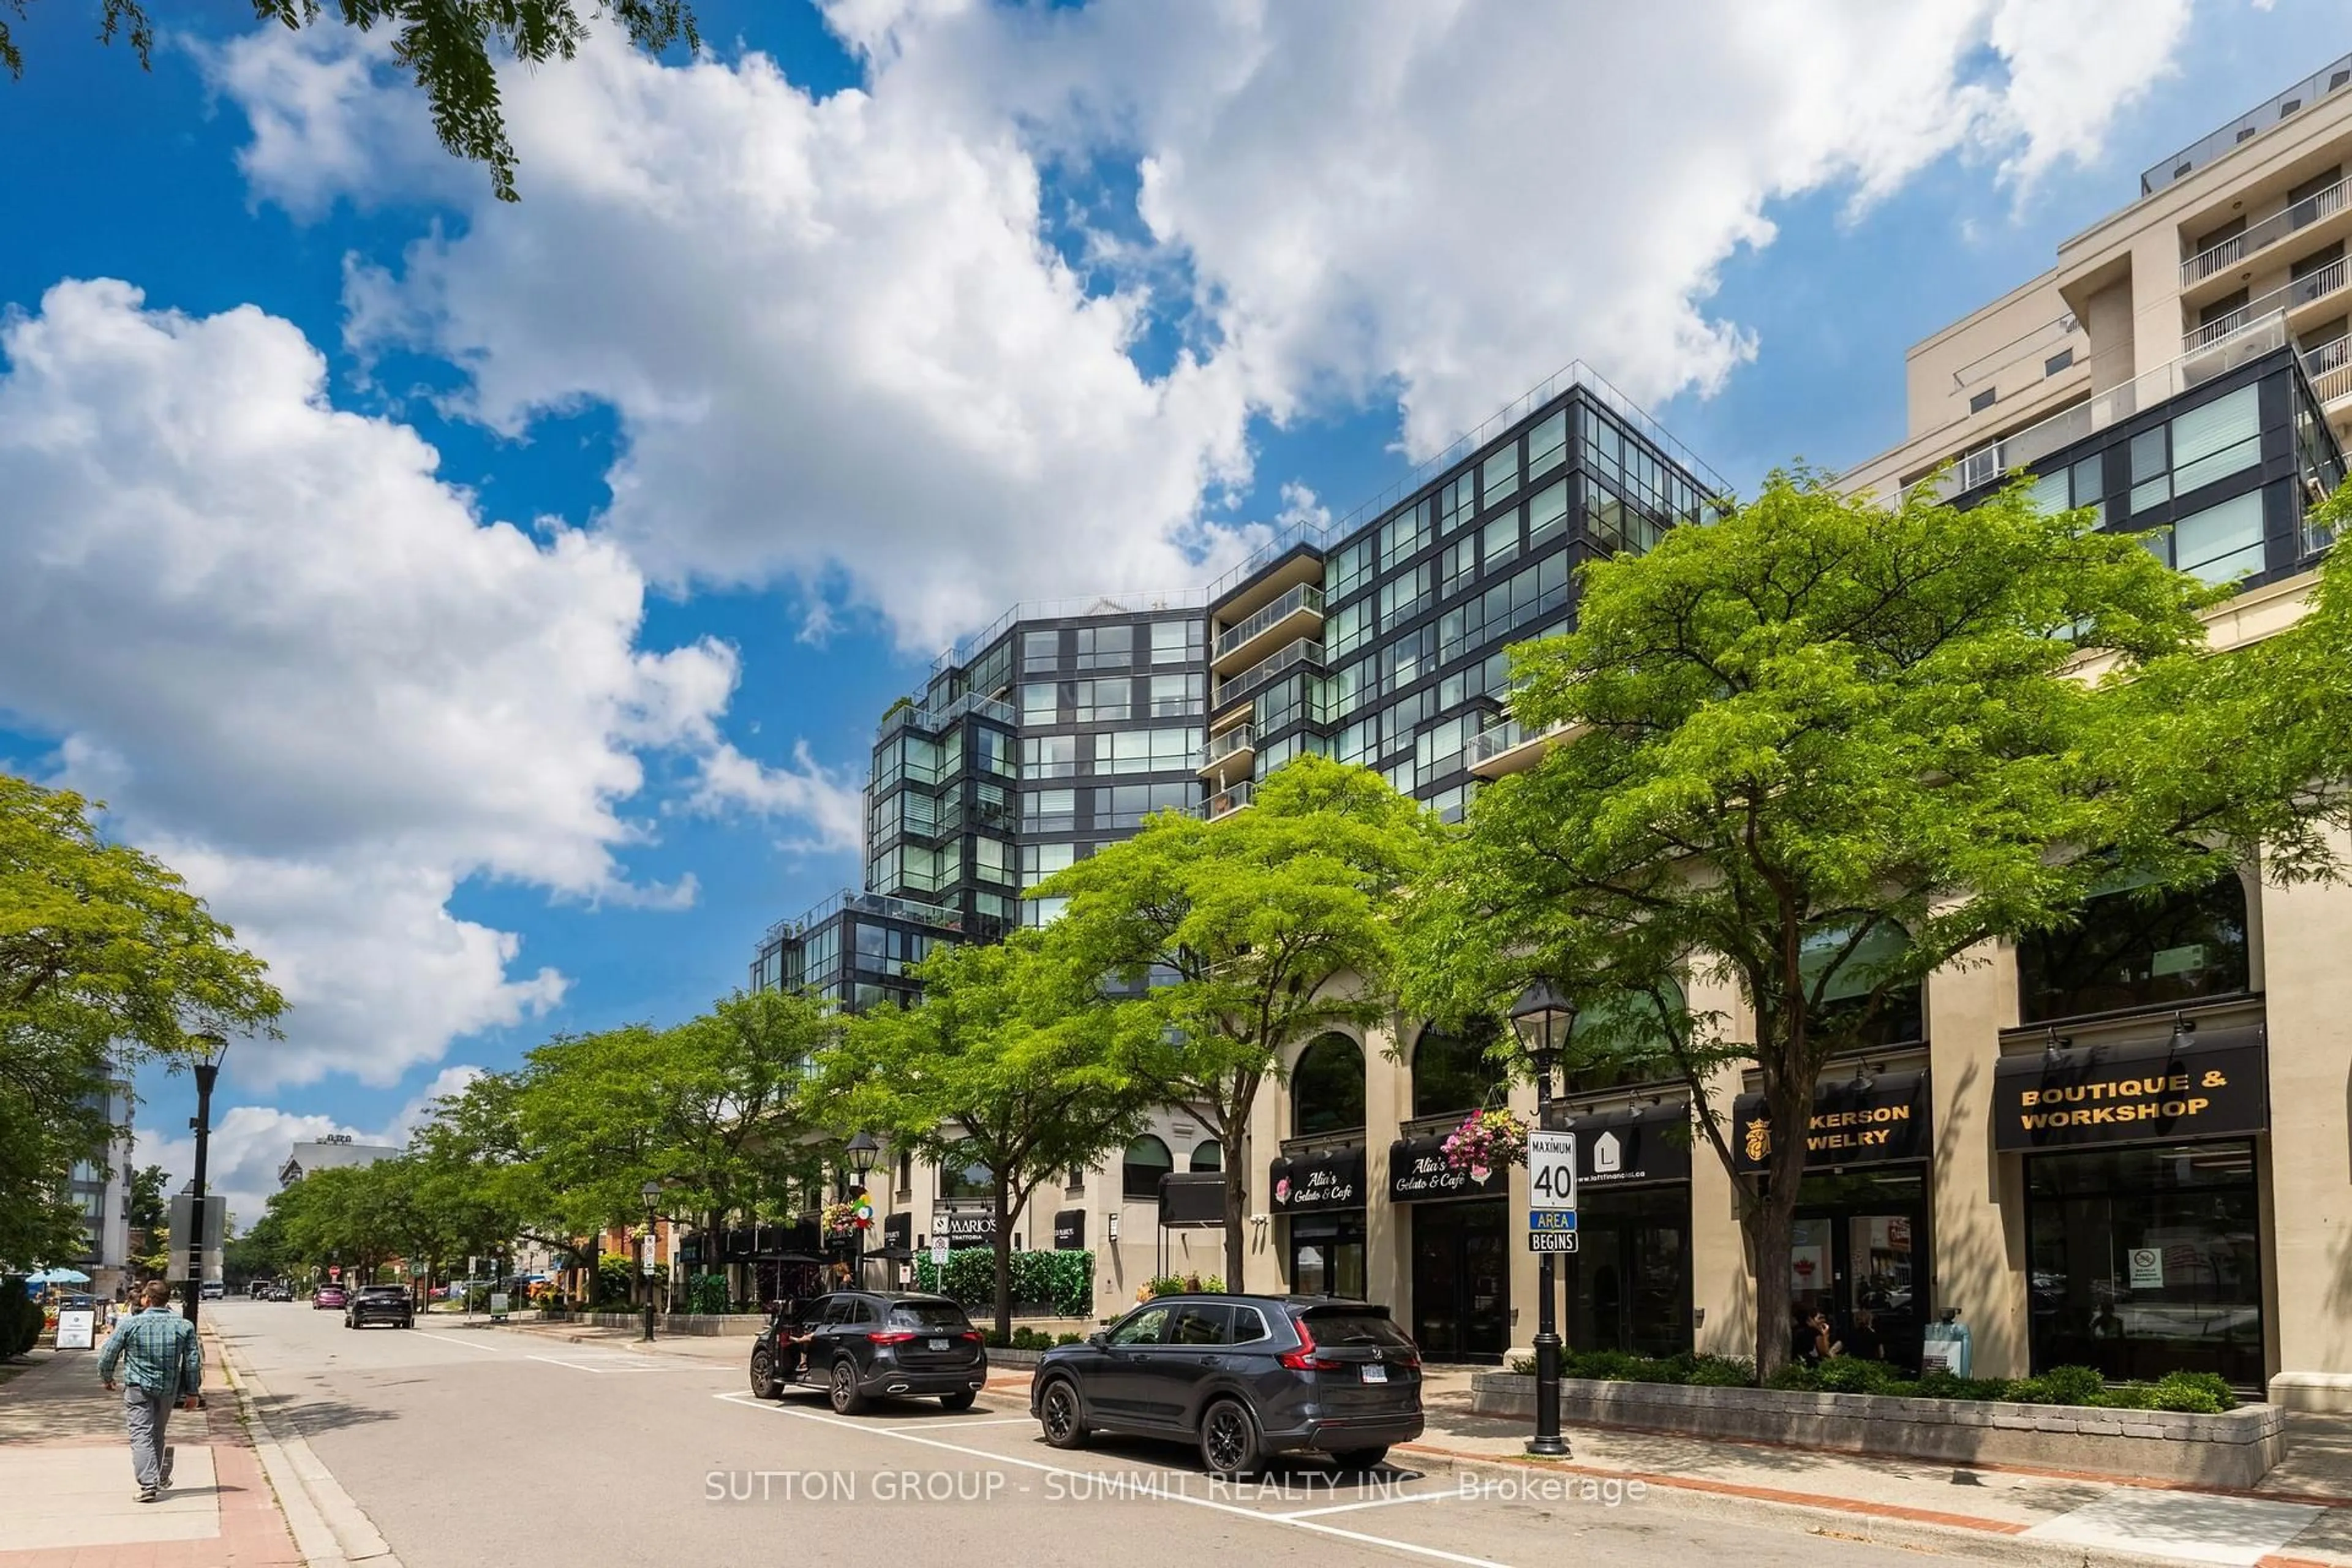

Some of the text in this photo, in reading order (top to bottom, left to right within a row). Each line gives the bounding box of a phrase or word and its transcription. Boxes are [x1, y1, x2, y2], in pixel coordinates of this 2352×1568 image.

[2022, 1070, 2227, 1107] BOUTIQUE &
[1808, 1104, 1910, 1130] KERSON
[2021, 1098, 2210, 1130] WORKSHOP
[1532, 1140, 1572, 1155] MAXIMUM
[1806, 1129, 1891, 1151] WELRY
[1601, 1147, 1614, 1164] L
[1396, 1177, 1427, 1191] Gelato
[1429, 1174, 1439, 1188] &
[1534, 1165, 1572, 1199] 40
[1538, 1213, 1569, 1228] AREA
[1532, 1234, 1573, 1250] BEGINS
